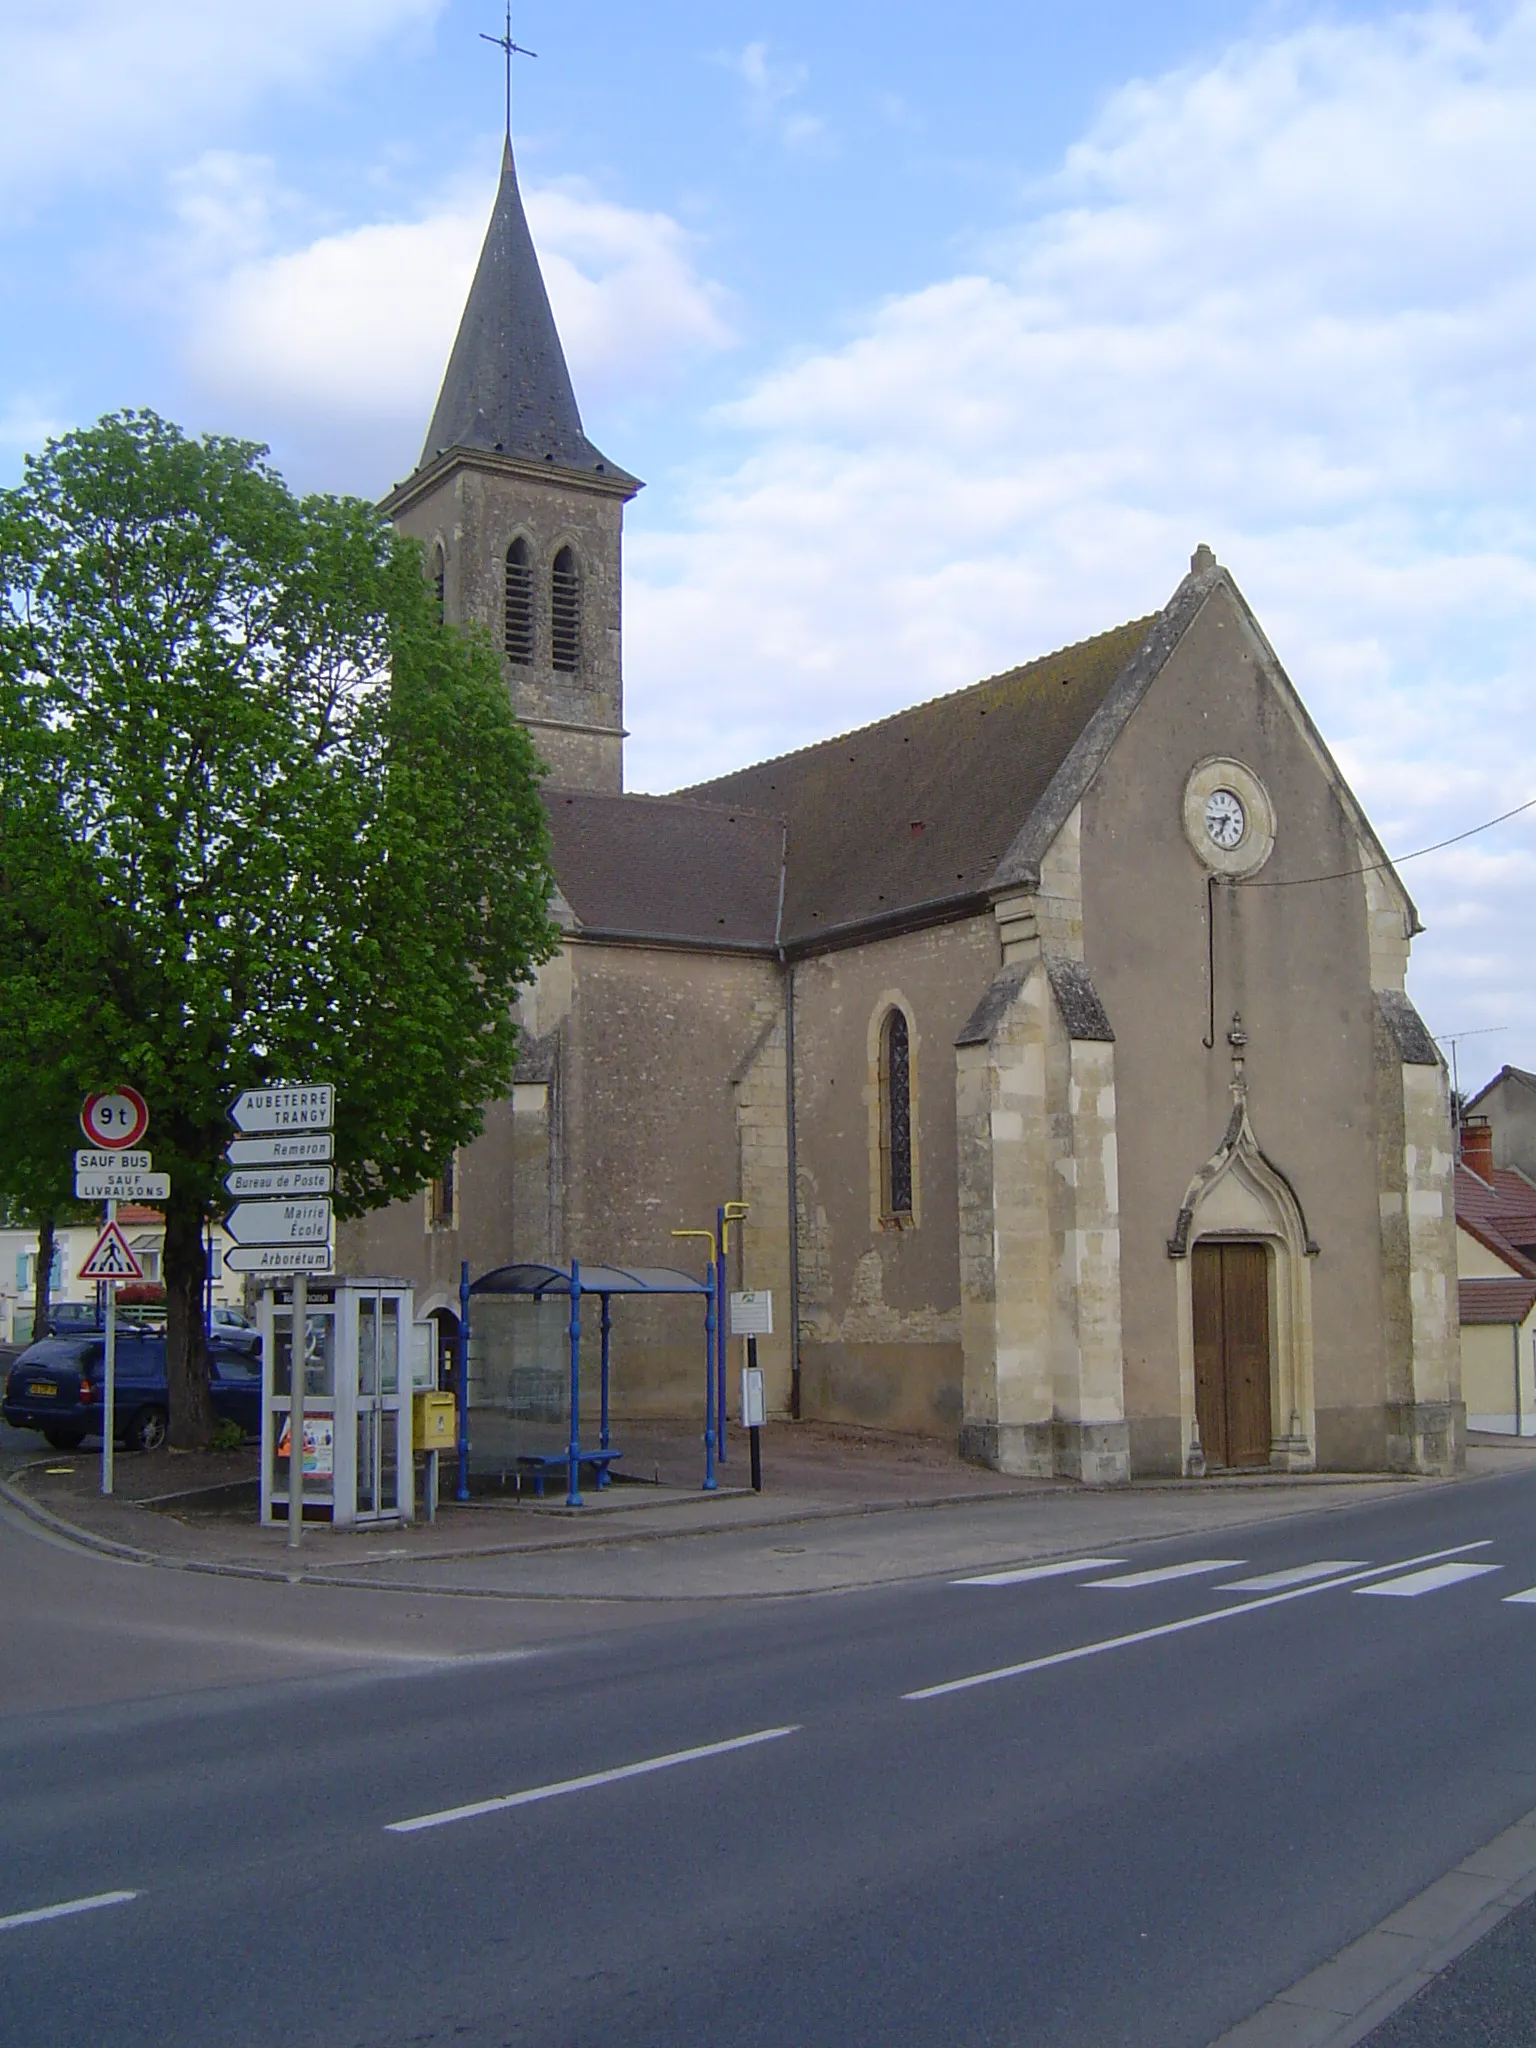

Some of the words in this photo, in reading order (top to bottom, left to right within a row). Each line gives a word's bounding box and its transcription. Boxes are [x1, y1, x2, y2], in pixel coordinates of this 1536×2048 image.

[246, 1092, 327, 1109] AUBETERRE
[100, 1107, 113, 1126] 9
[119, 1107, 128, 1126] t
[275, 1109, 326, 1123] TRANGY
[273, 1143, 326, 1156] Remeron
[80, 1155, 115, 1167] SAUF
[121, 1155, 148, 1167] BUS
[107, 1175, 141, 1185] SAUF
[235, 1176, 272, 1188] Bureau
[276, 1175, 290, 1187] de
[294, 1173, 325, 1187] Poste
[84, 1186, 164, 1196] LIVRAISONS
[284, 1206, 324, 1219] Mairie
[290, 1220, 324, 1237] École
[260, 1251, 325, 1265] Arborétum
